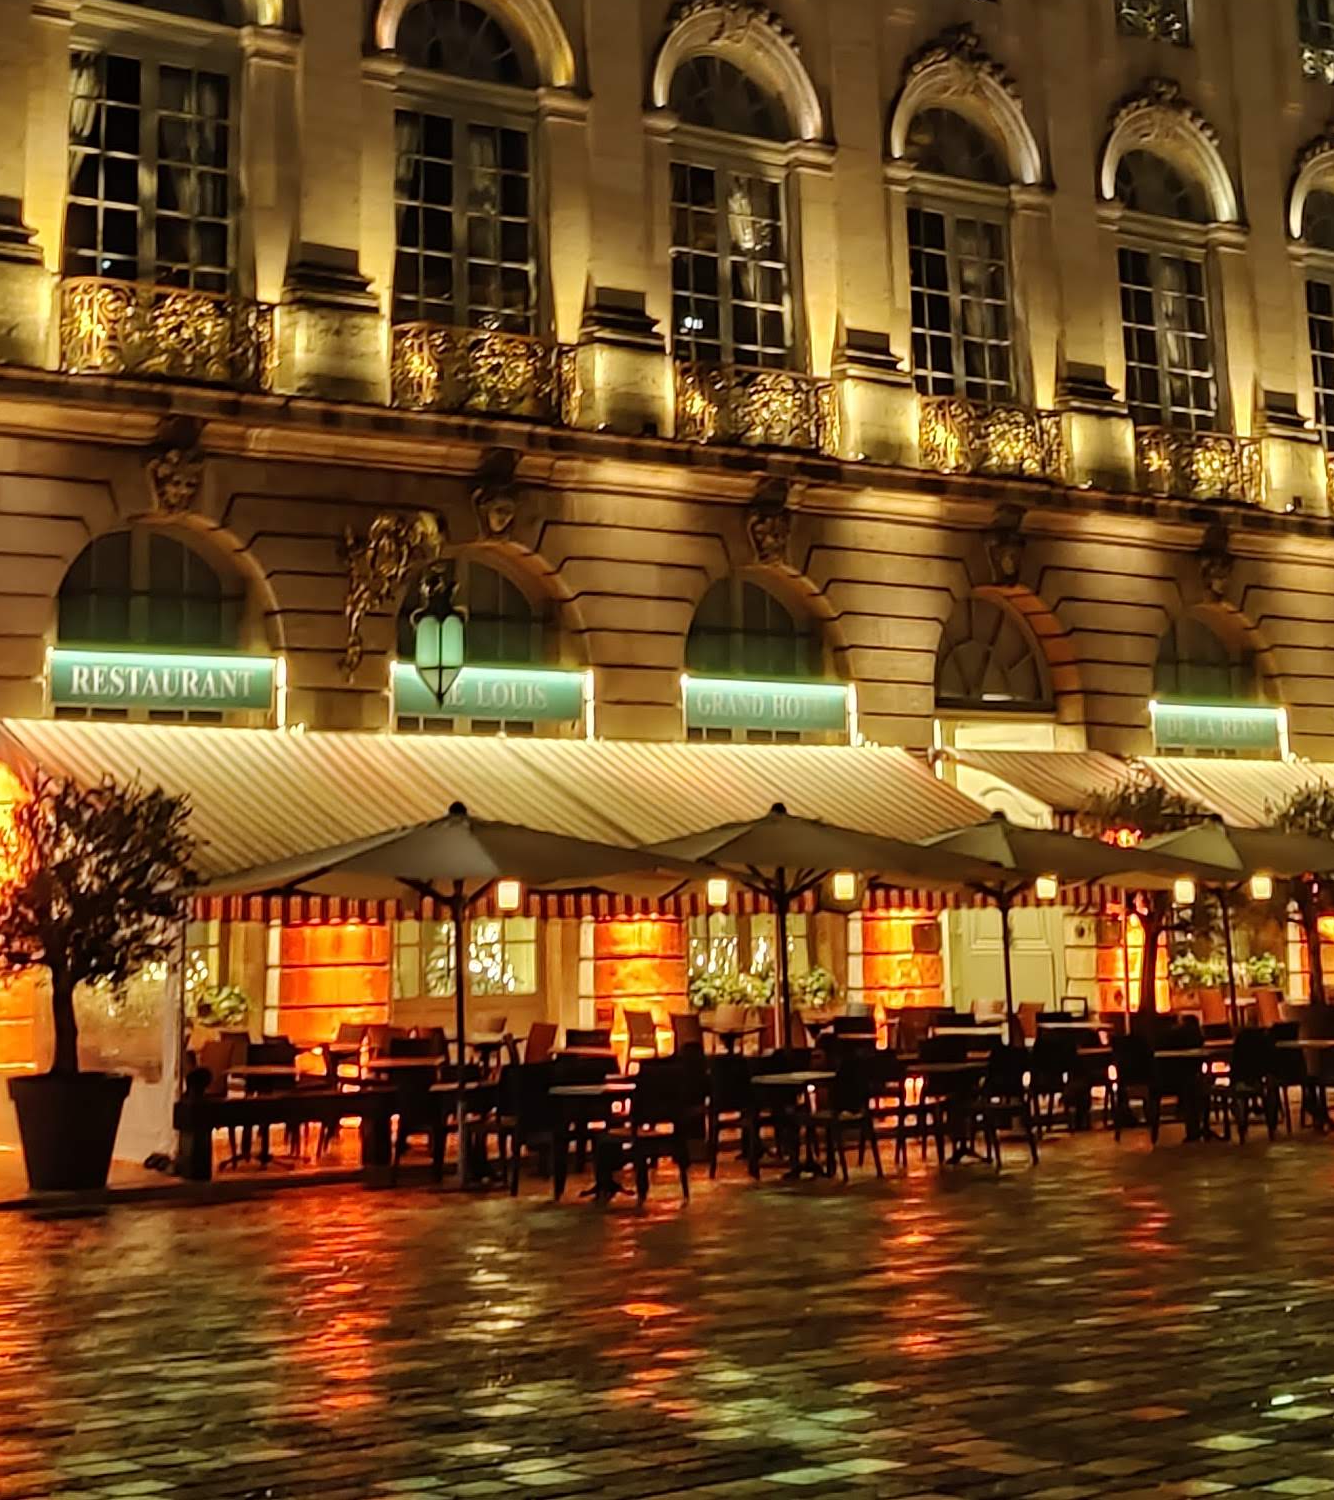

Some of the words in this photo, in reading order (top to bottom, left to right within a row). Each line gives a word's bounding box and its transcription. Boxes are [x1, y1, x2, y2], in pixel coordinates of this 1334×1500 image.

[70, 663, 255, 698] RESTAURANT
[476, 680, 548, 710] LOUIS
[697, 692, 765, 719] GRAND
[772, 694, 828, 722] HOT
[1221, 717, 1266, 740] REIN
